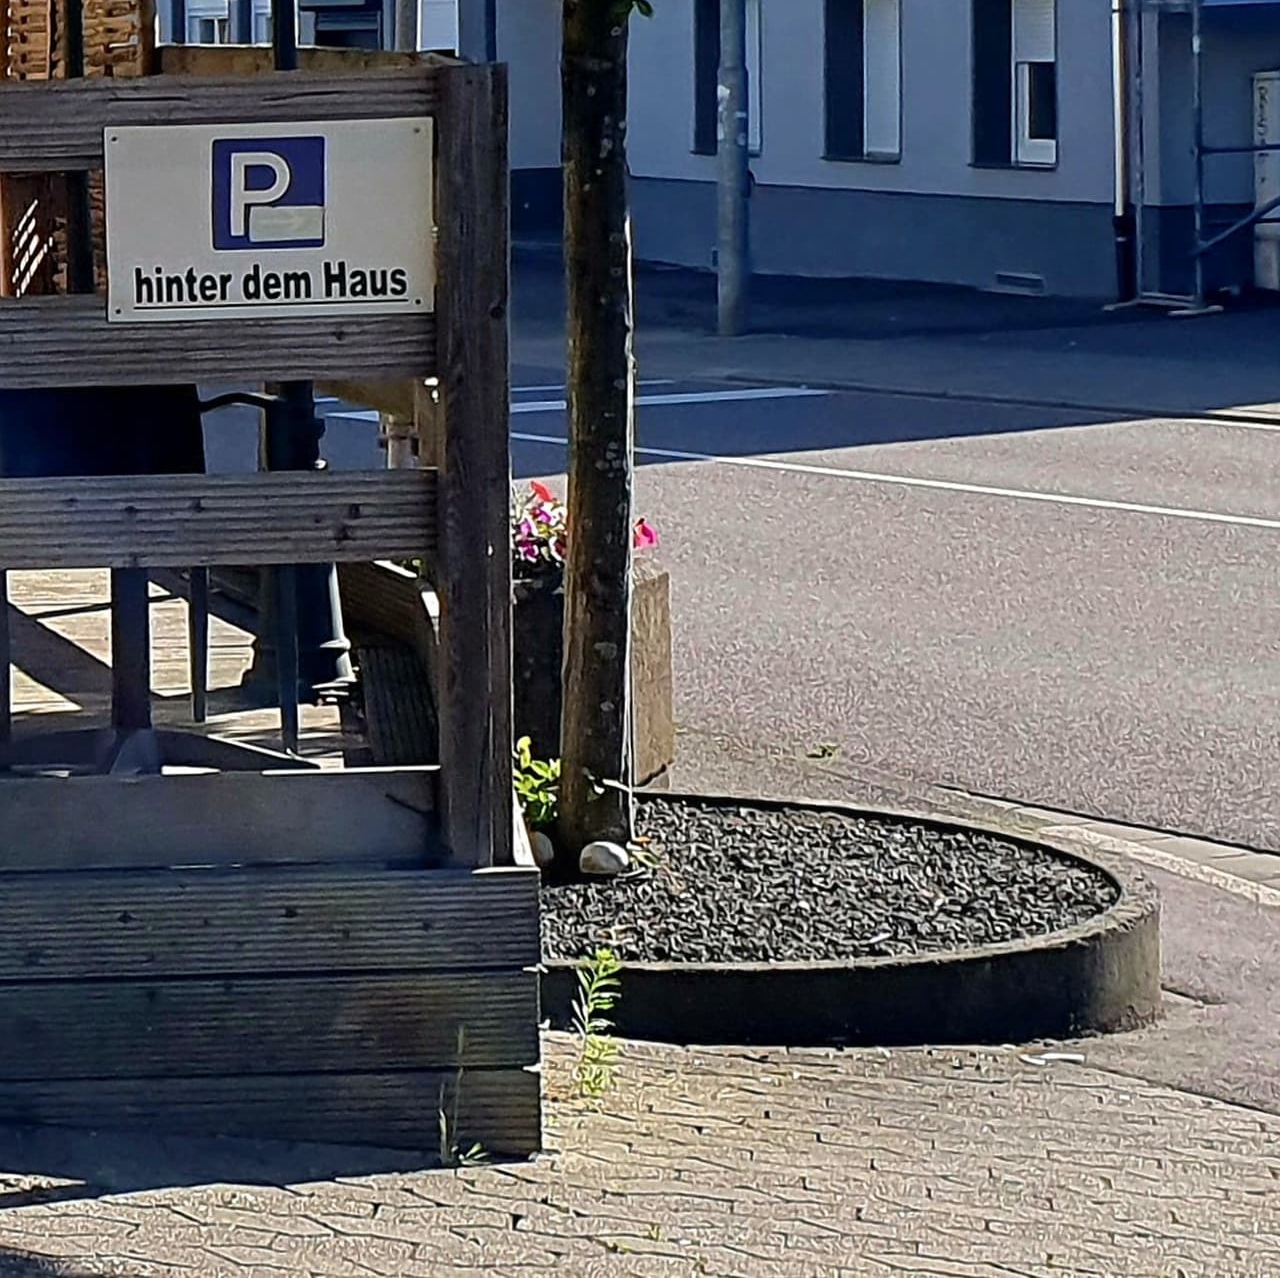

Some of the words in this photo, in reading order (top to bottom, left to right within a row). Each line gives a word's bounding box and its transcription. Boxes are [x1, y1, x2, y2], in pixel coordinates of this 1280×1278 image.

[230, 151, 291, 237] P
[134, 266, 232, 304] hinter
[242, 263, 312, 300] dem
[323, 260, 408, 298] Haus
